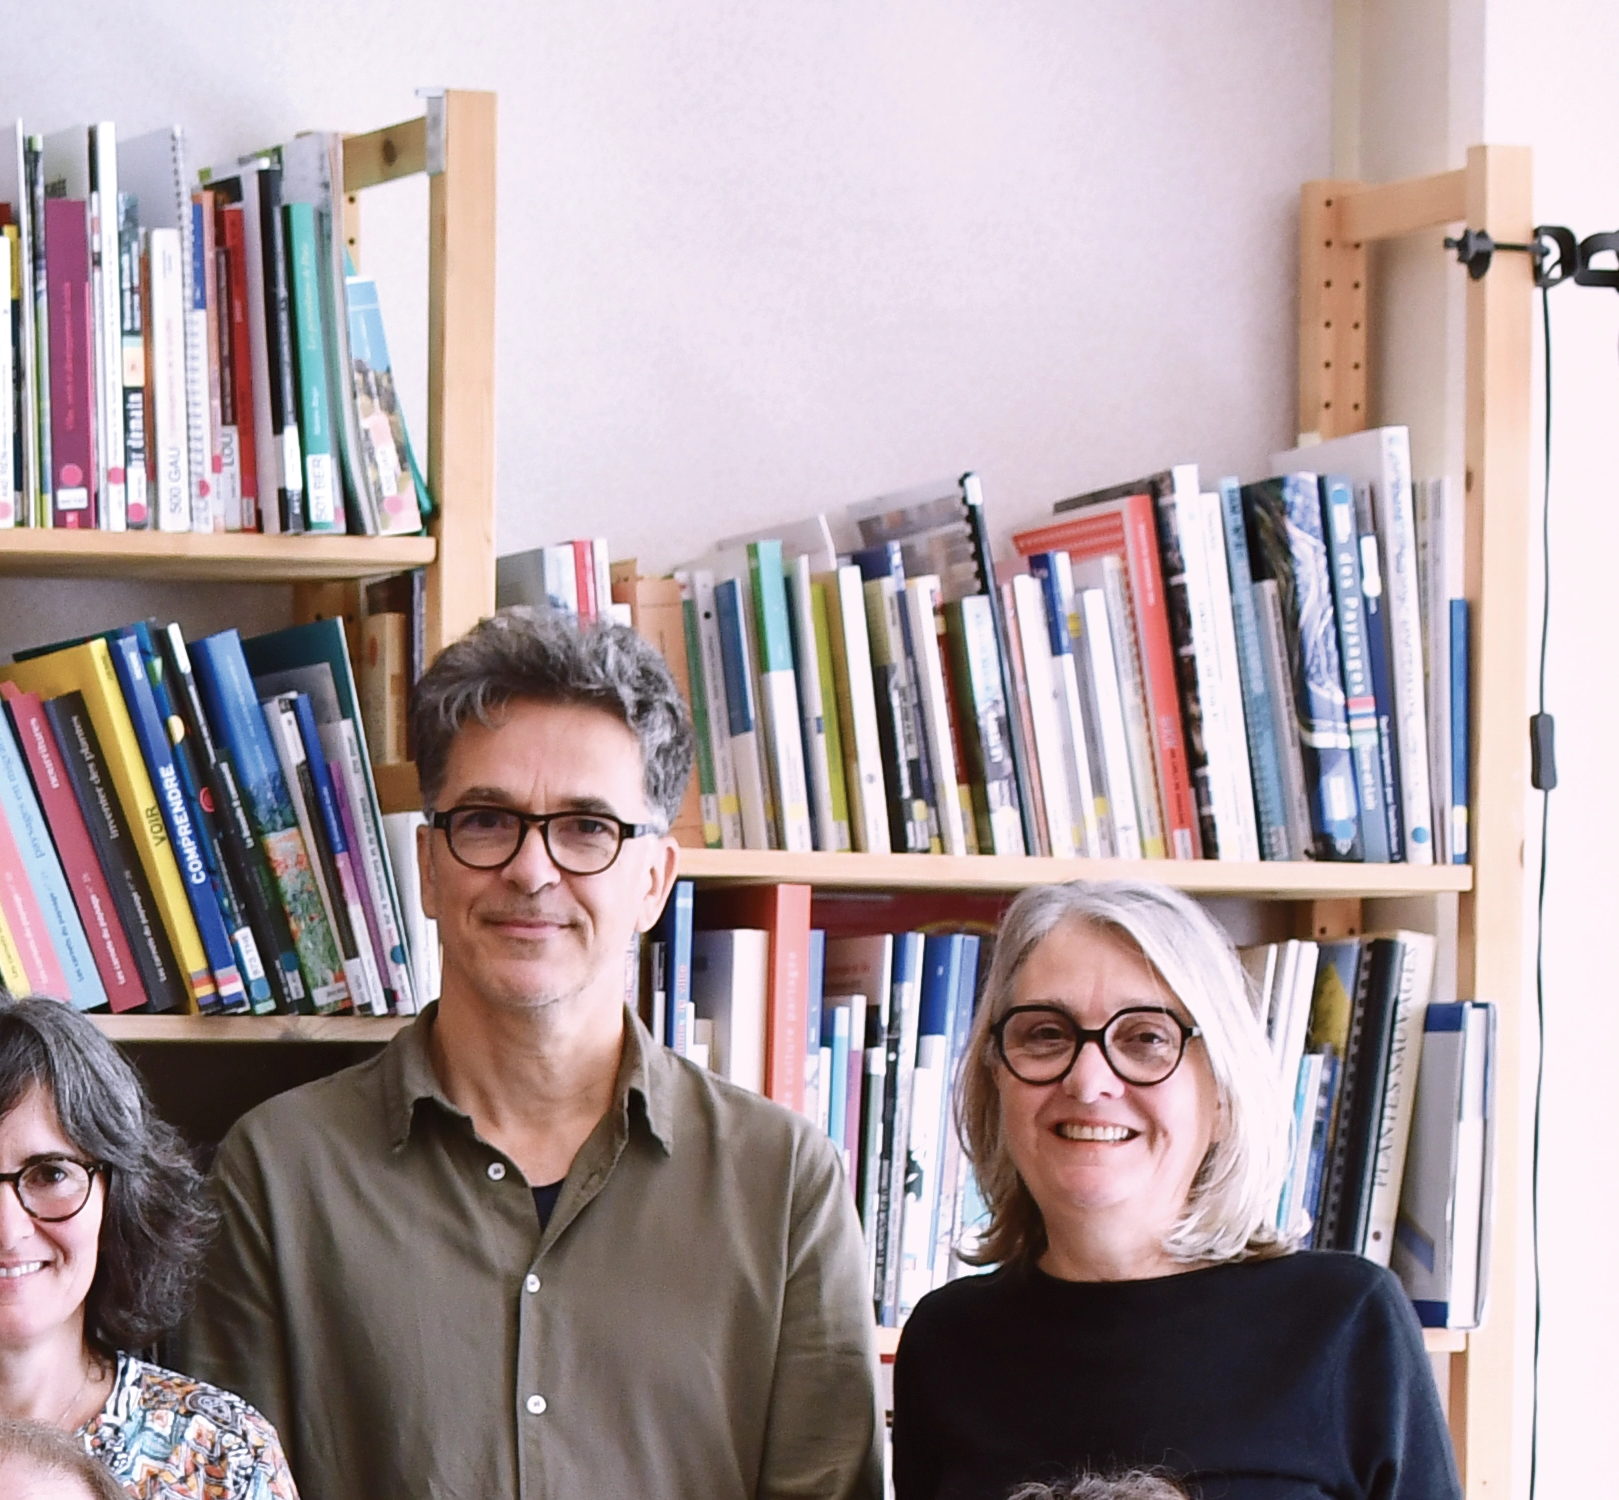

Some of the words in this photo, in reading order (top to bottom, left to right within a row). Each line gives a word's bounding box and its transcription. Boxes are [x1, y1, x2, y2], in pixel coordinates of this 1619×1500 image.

[169, 446, 182, 482] GAU
[169, 486, 182, 514] 500
[1337, 552, 1358, 589] des
[1341, 597, 1369, 696] Paysages
[71, 715, 95, 761] plantes
[89, 763, 102, 784] des
[145, 805, 166, 847] VOIR
[160, 763, 207, 884] COMPRENDRE
